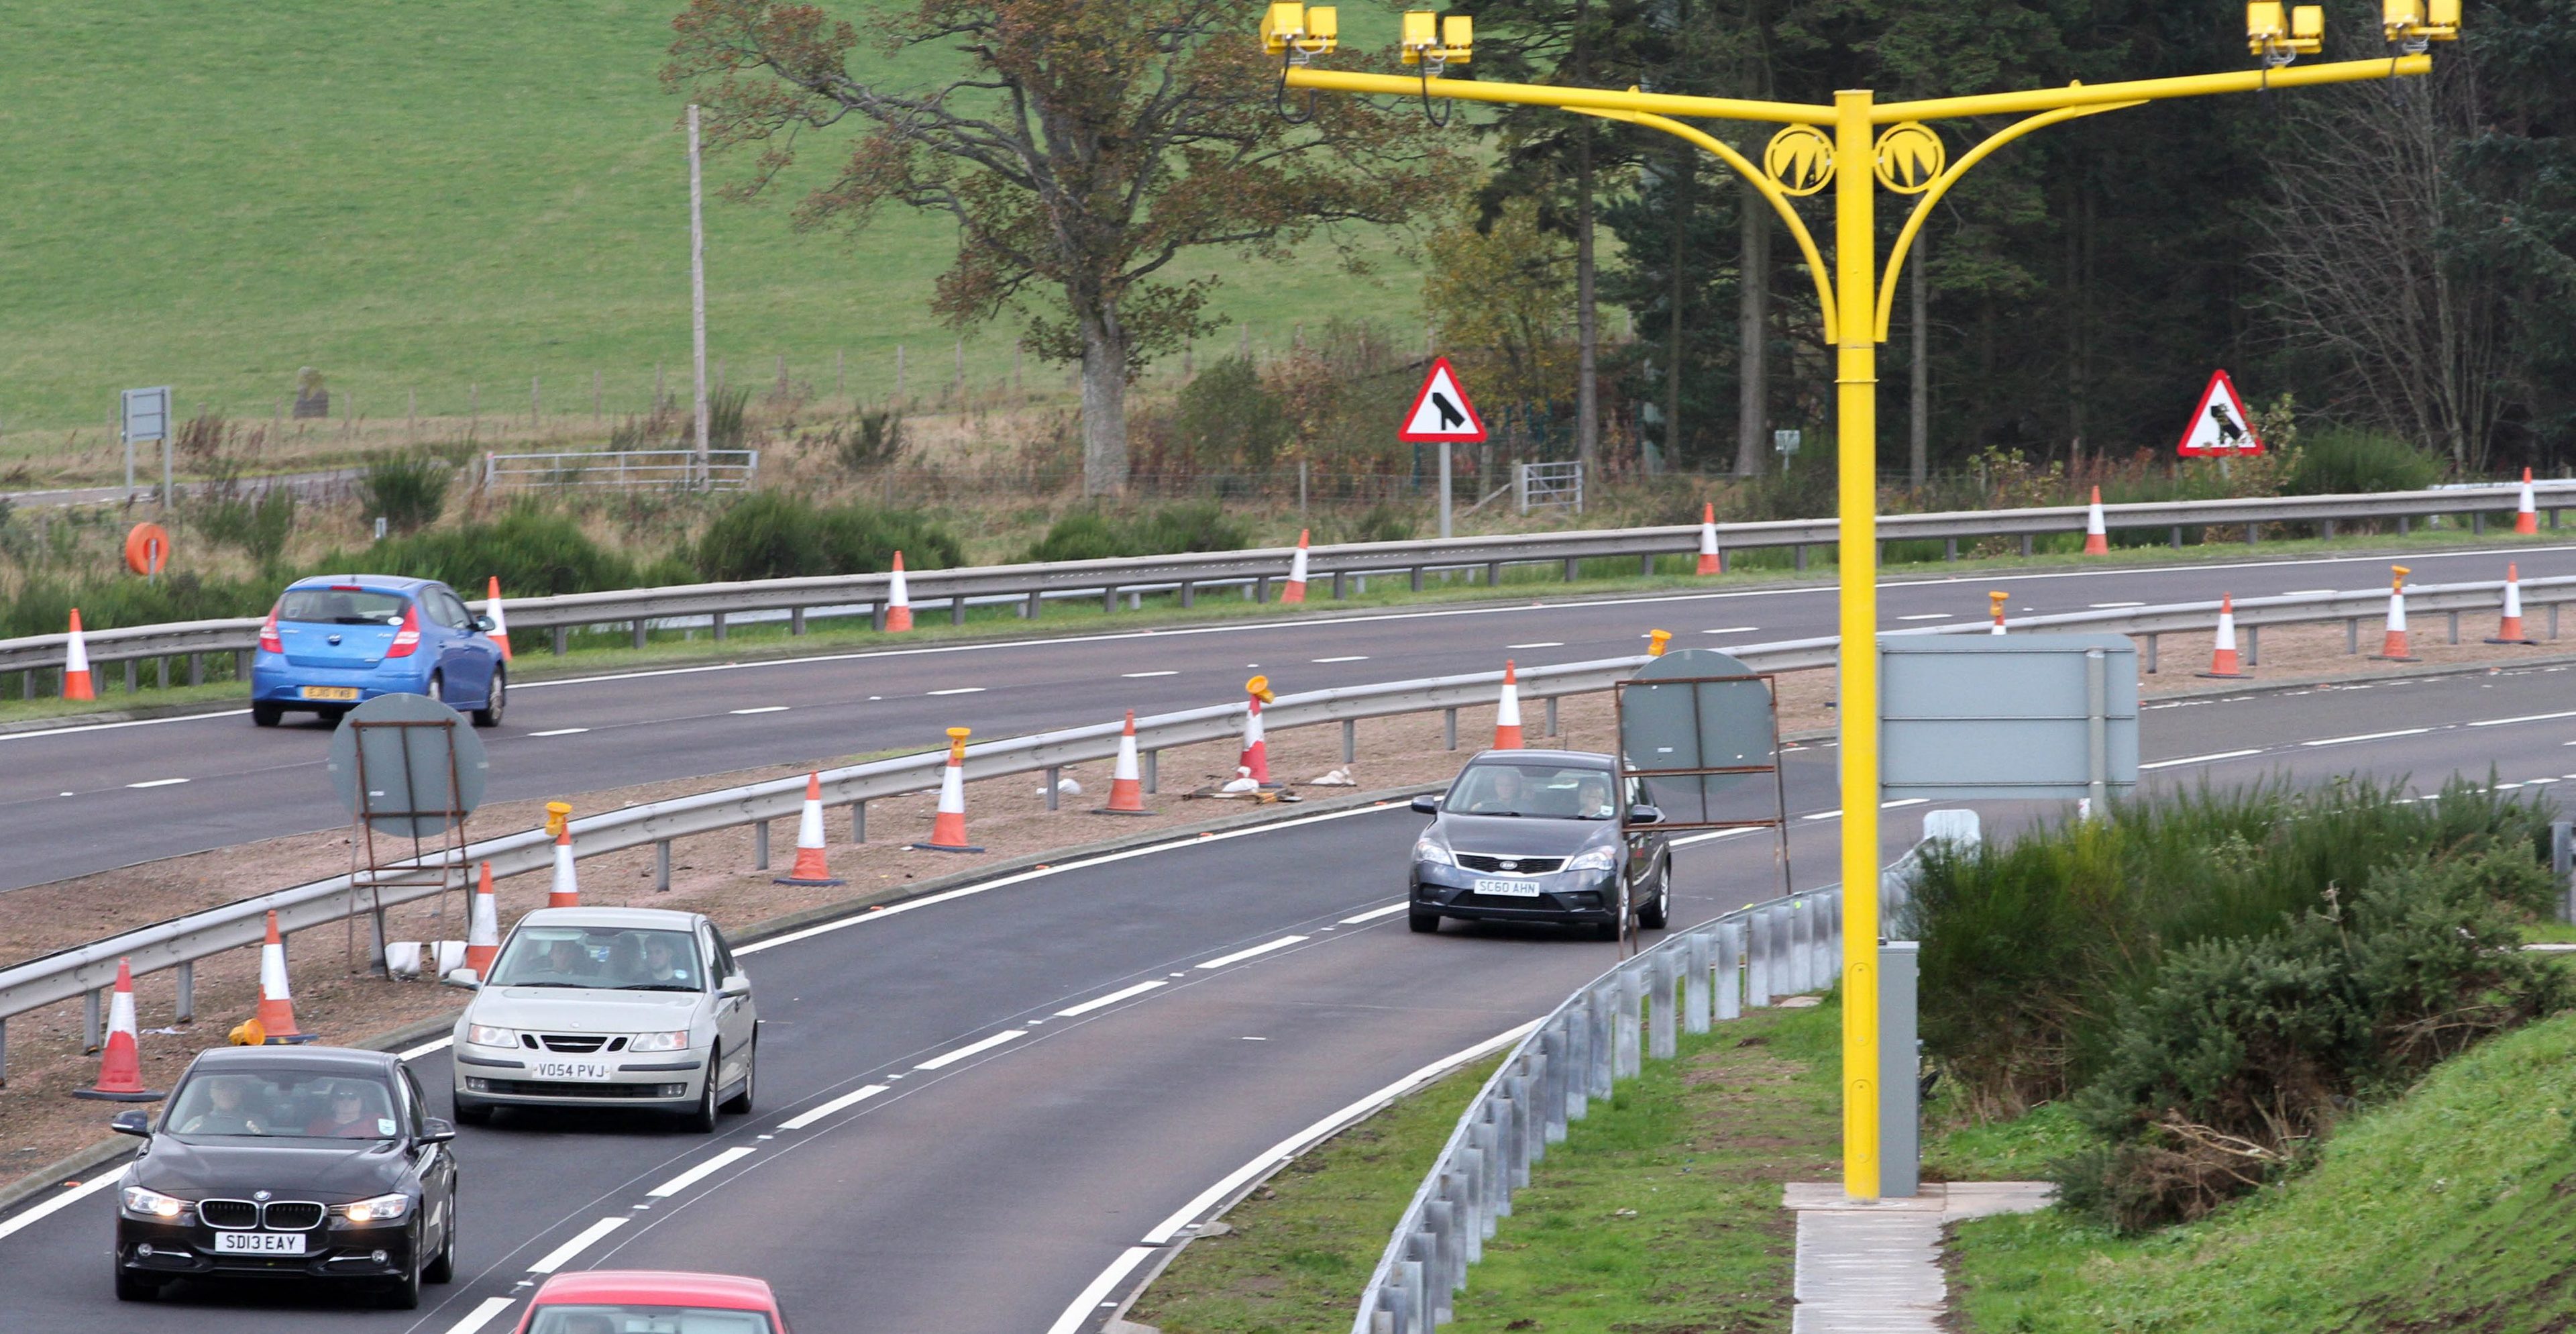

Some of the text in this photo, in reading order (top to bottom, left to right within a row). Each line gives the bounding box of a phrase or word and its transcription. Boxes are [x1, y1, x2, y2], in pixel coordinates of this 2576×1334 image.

[1480, 881, 1535, 893] SC60 AHN
[539, 1064, 604, 1077] VO54 PVJ
[226, 1235, 296, 1249] SD13 EAY
